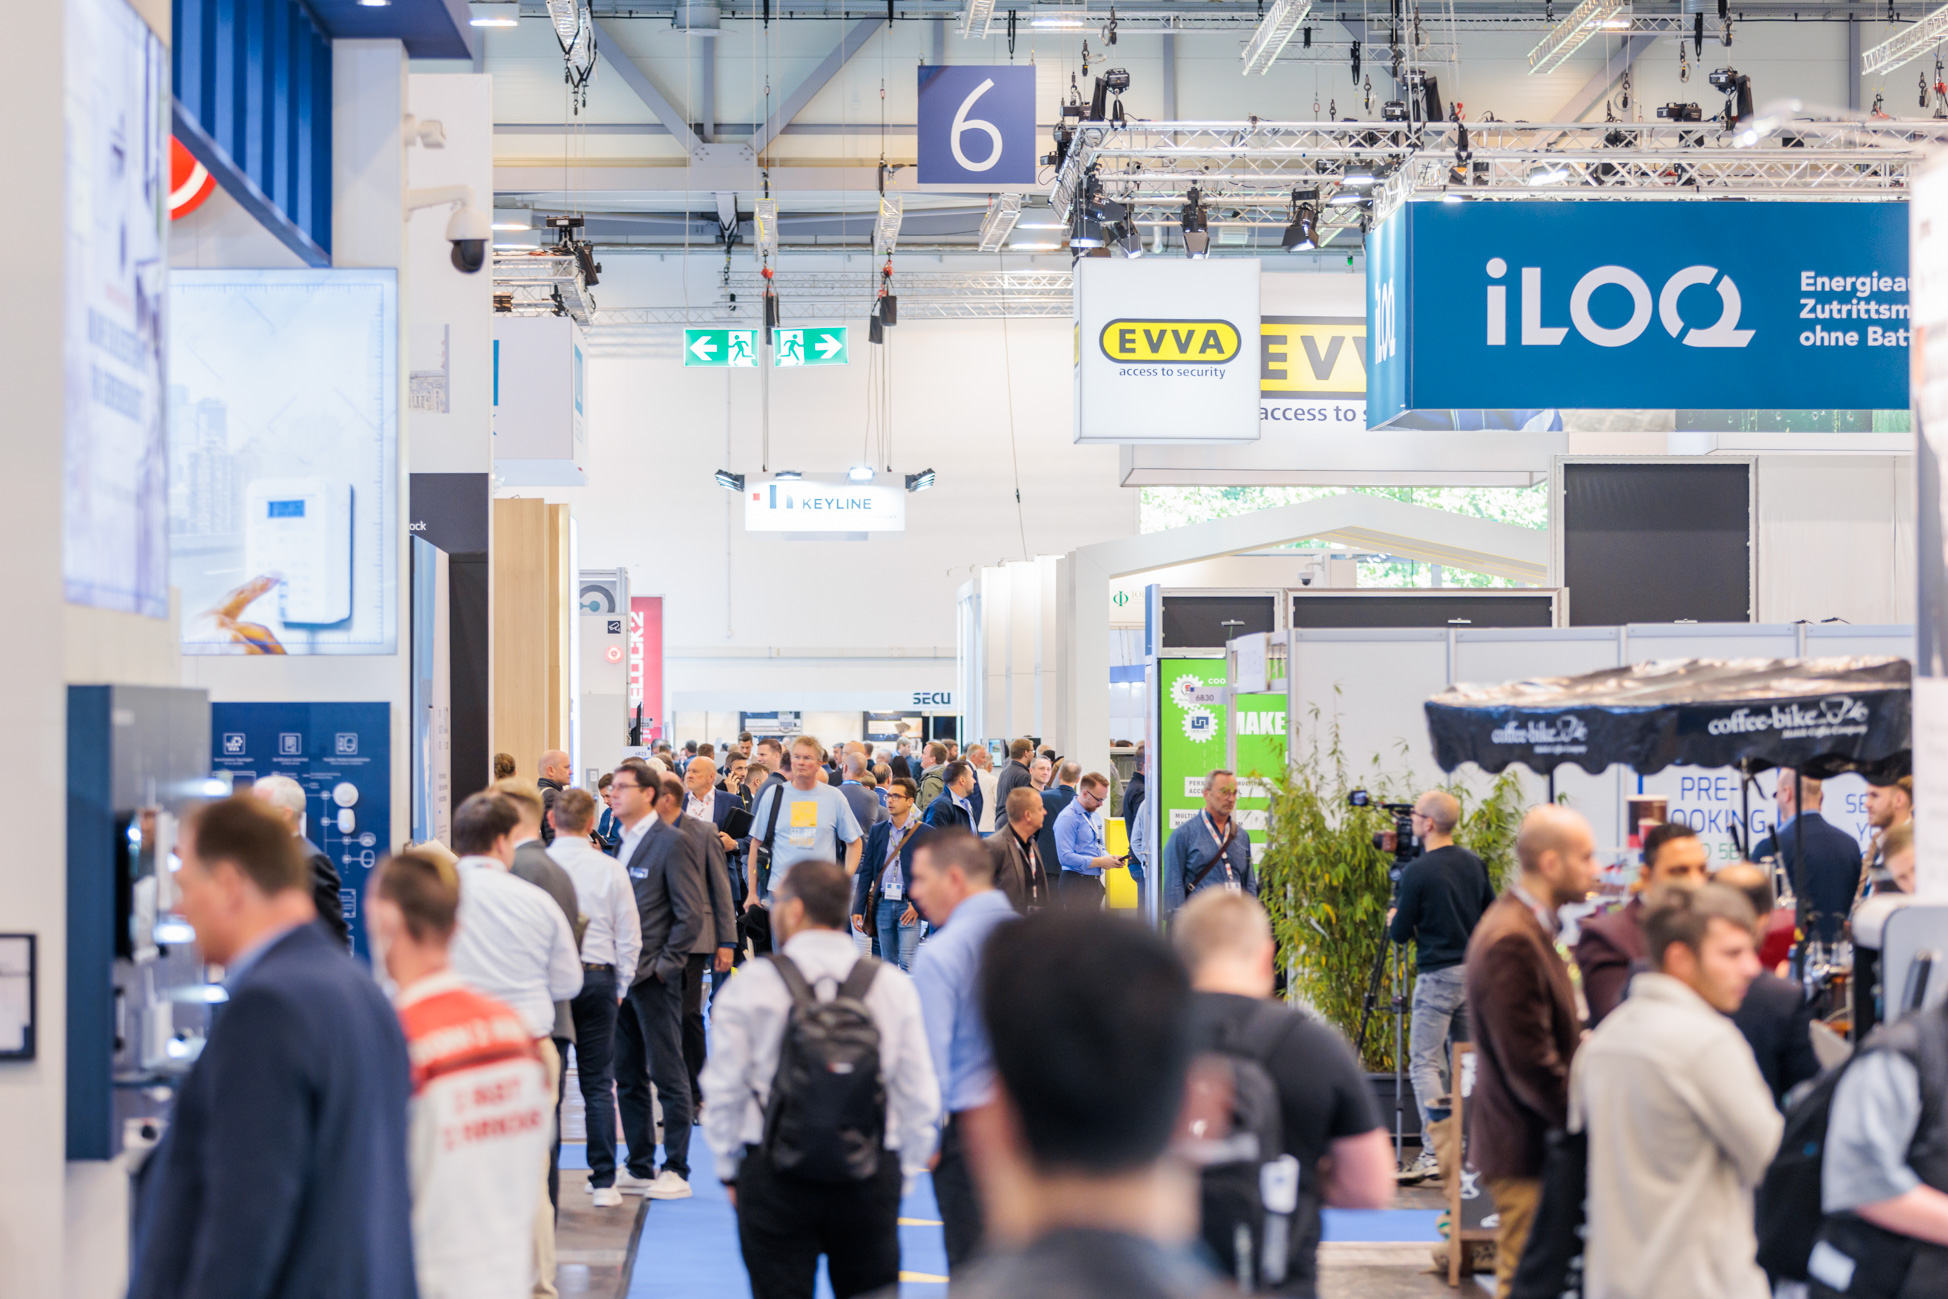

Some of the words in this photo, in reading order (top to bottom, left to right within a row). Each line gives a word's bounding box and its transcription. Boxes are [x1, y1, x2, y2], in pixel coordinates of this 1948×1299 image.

[950, 78, 1003, 172] 6
[1486, 257, 1756, 348] iLOQ
[1118, 329, 1225, 354] EVVA
[1800, 324, 1859, 346] ohne
[1119, 367, 1158, 377] access
[1161, 367, 1173, 377] to
[1177, 366, 1226, 379] security
[1334, 405, 1357, 422] to
[802, 499, 872, 509] KEYLINE
[913, 692, 951, 705] SECU
[1195, 694, 1214, 702] 6830
[1681, 777, 1738, 801] PRE-
